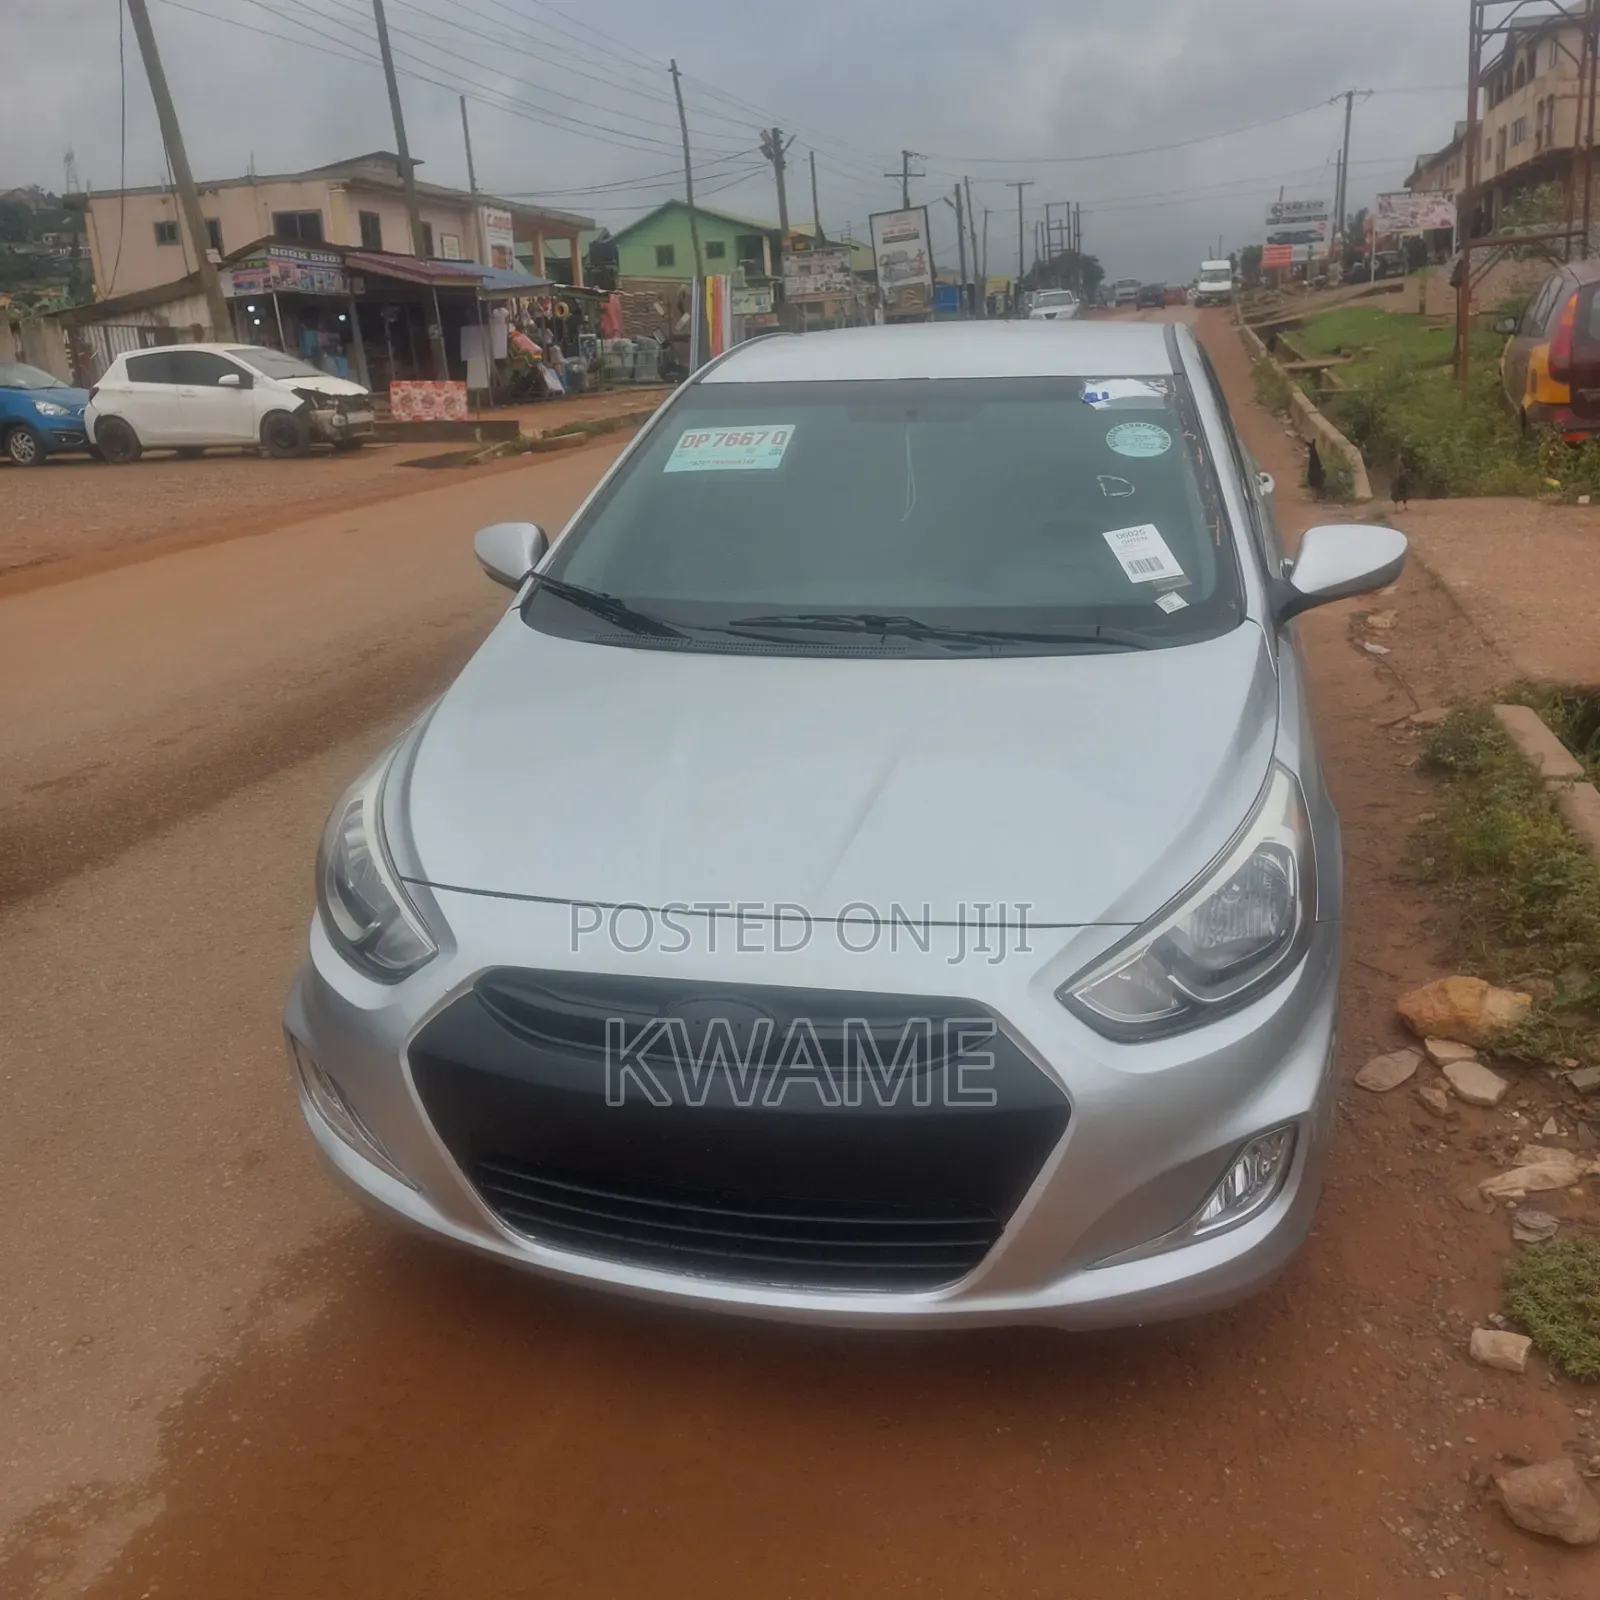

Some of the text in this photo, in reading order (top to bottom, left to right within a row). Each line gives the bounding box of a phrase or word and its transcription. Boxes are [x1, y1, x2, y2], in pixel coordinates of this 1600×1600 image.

[270, 248, 308, 260] BOOK
[680, 434, 711, 449] DP
[712, 431, 769, 448] 7667
